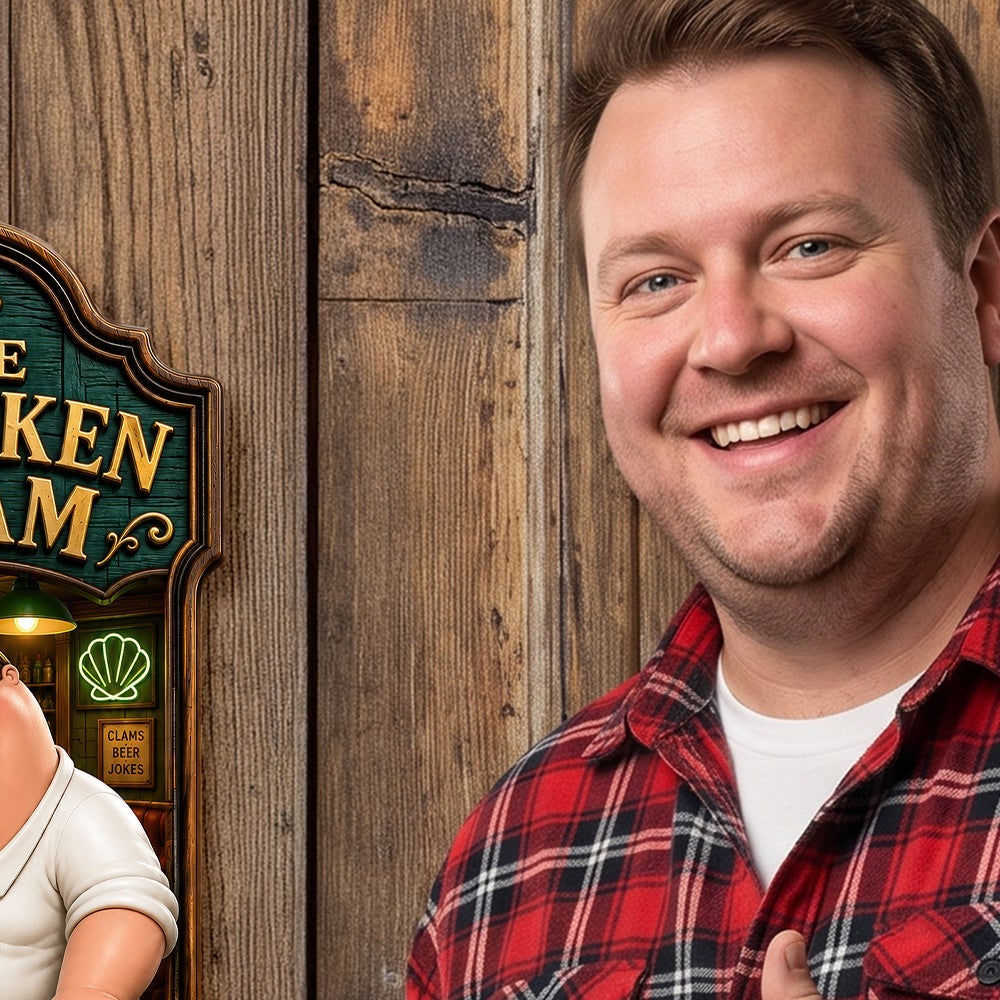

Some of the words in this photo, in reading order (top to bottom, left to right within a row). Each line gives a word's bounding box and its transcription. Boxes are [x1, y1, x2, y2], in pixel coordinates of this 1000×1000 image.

[107, 730, 145, 742] CLAMS
[112, 746, 140, 759] BEER
[107, 763, 145, 775] JOKES
